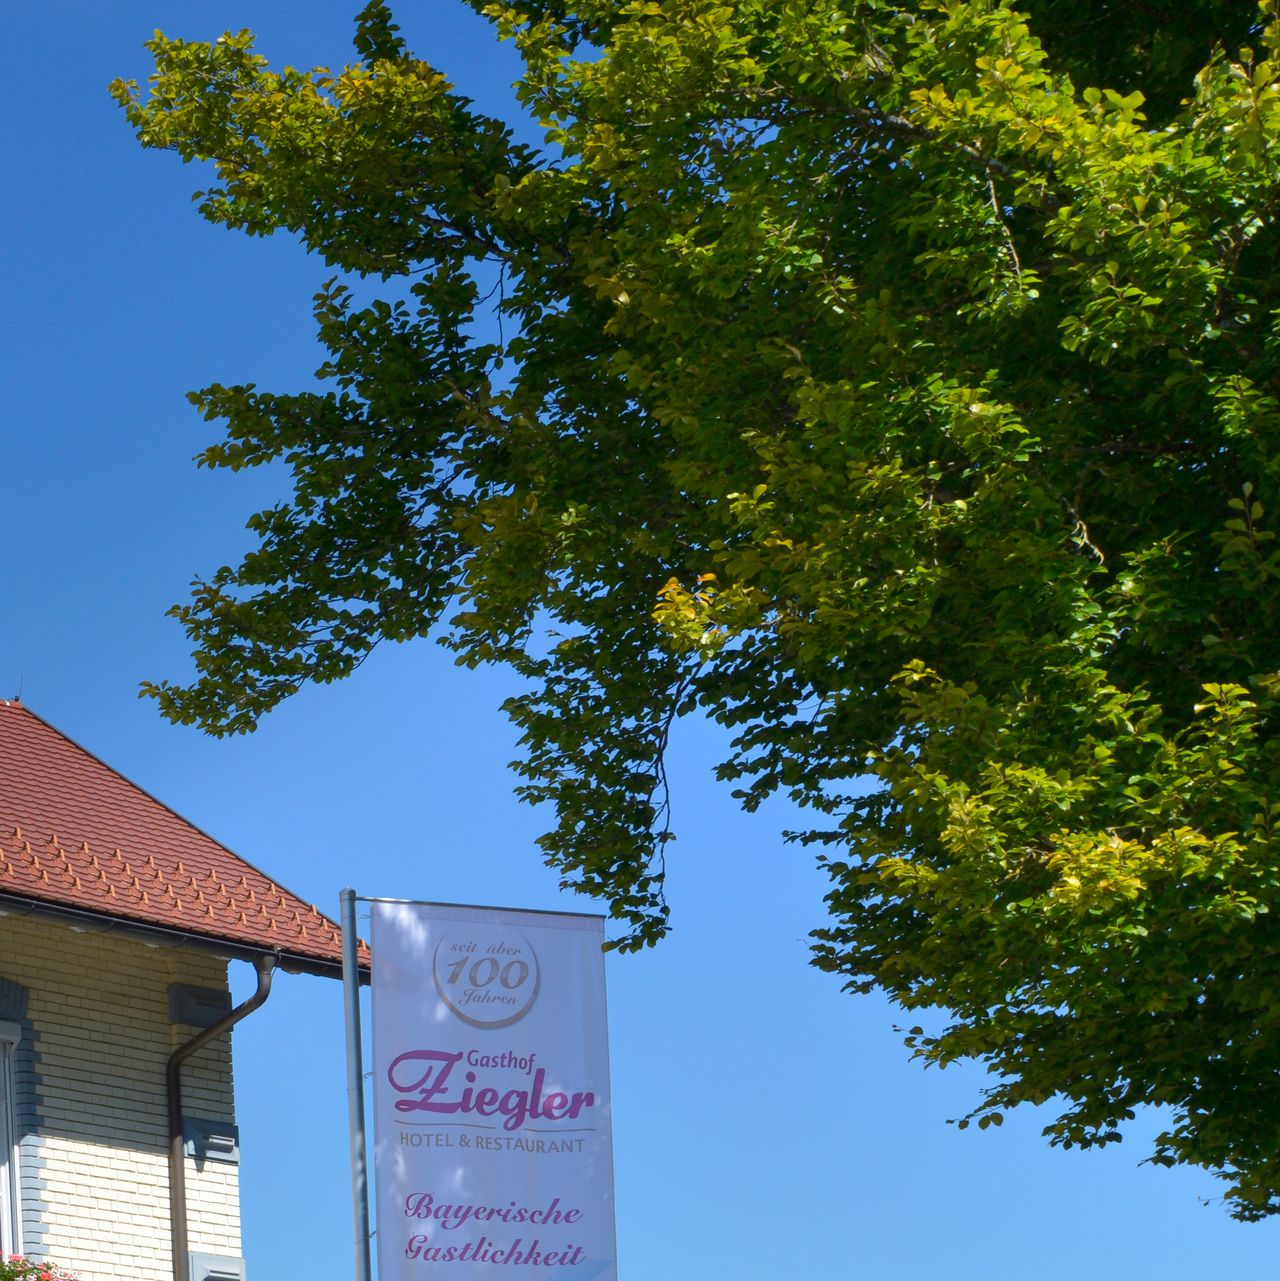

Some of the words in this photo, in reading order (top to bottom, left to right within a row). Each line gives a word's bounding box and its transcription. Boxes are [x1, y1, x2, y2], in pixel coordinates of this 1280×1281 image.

[450, 942, 477, 954] seit
[486, 941, 522, 955] über
[447, 956, 529, 990] 100
[458, 988, 517, 1006] Jahren
[466, 1050, 537, 1075] Gasthof
[388, 1050, 594, 1131] Ziegler
[399, 1131, 454, 1148] HOTEL
[458, 1134, 472, 1148] &
[476, 1136, 586, 1154] RESTAURANT
[404, 1192, 584, 1231] Bayerische
[404, 1232, 587, 1267] Gastlichkeit
